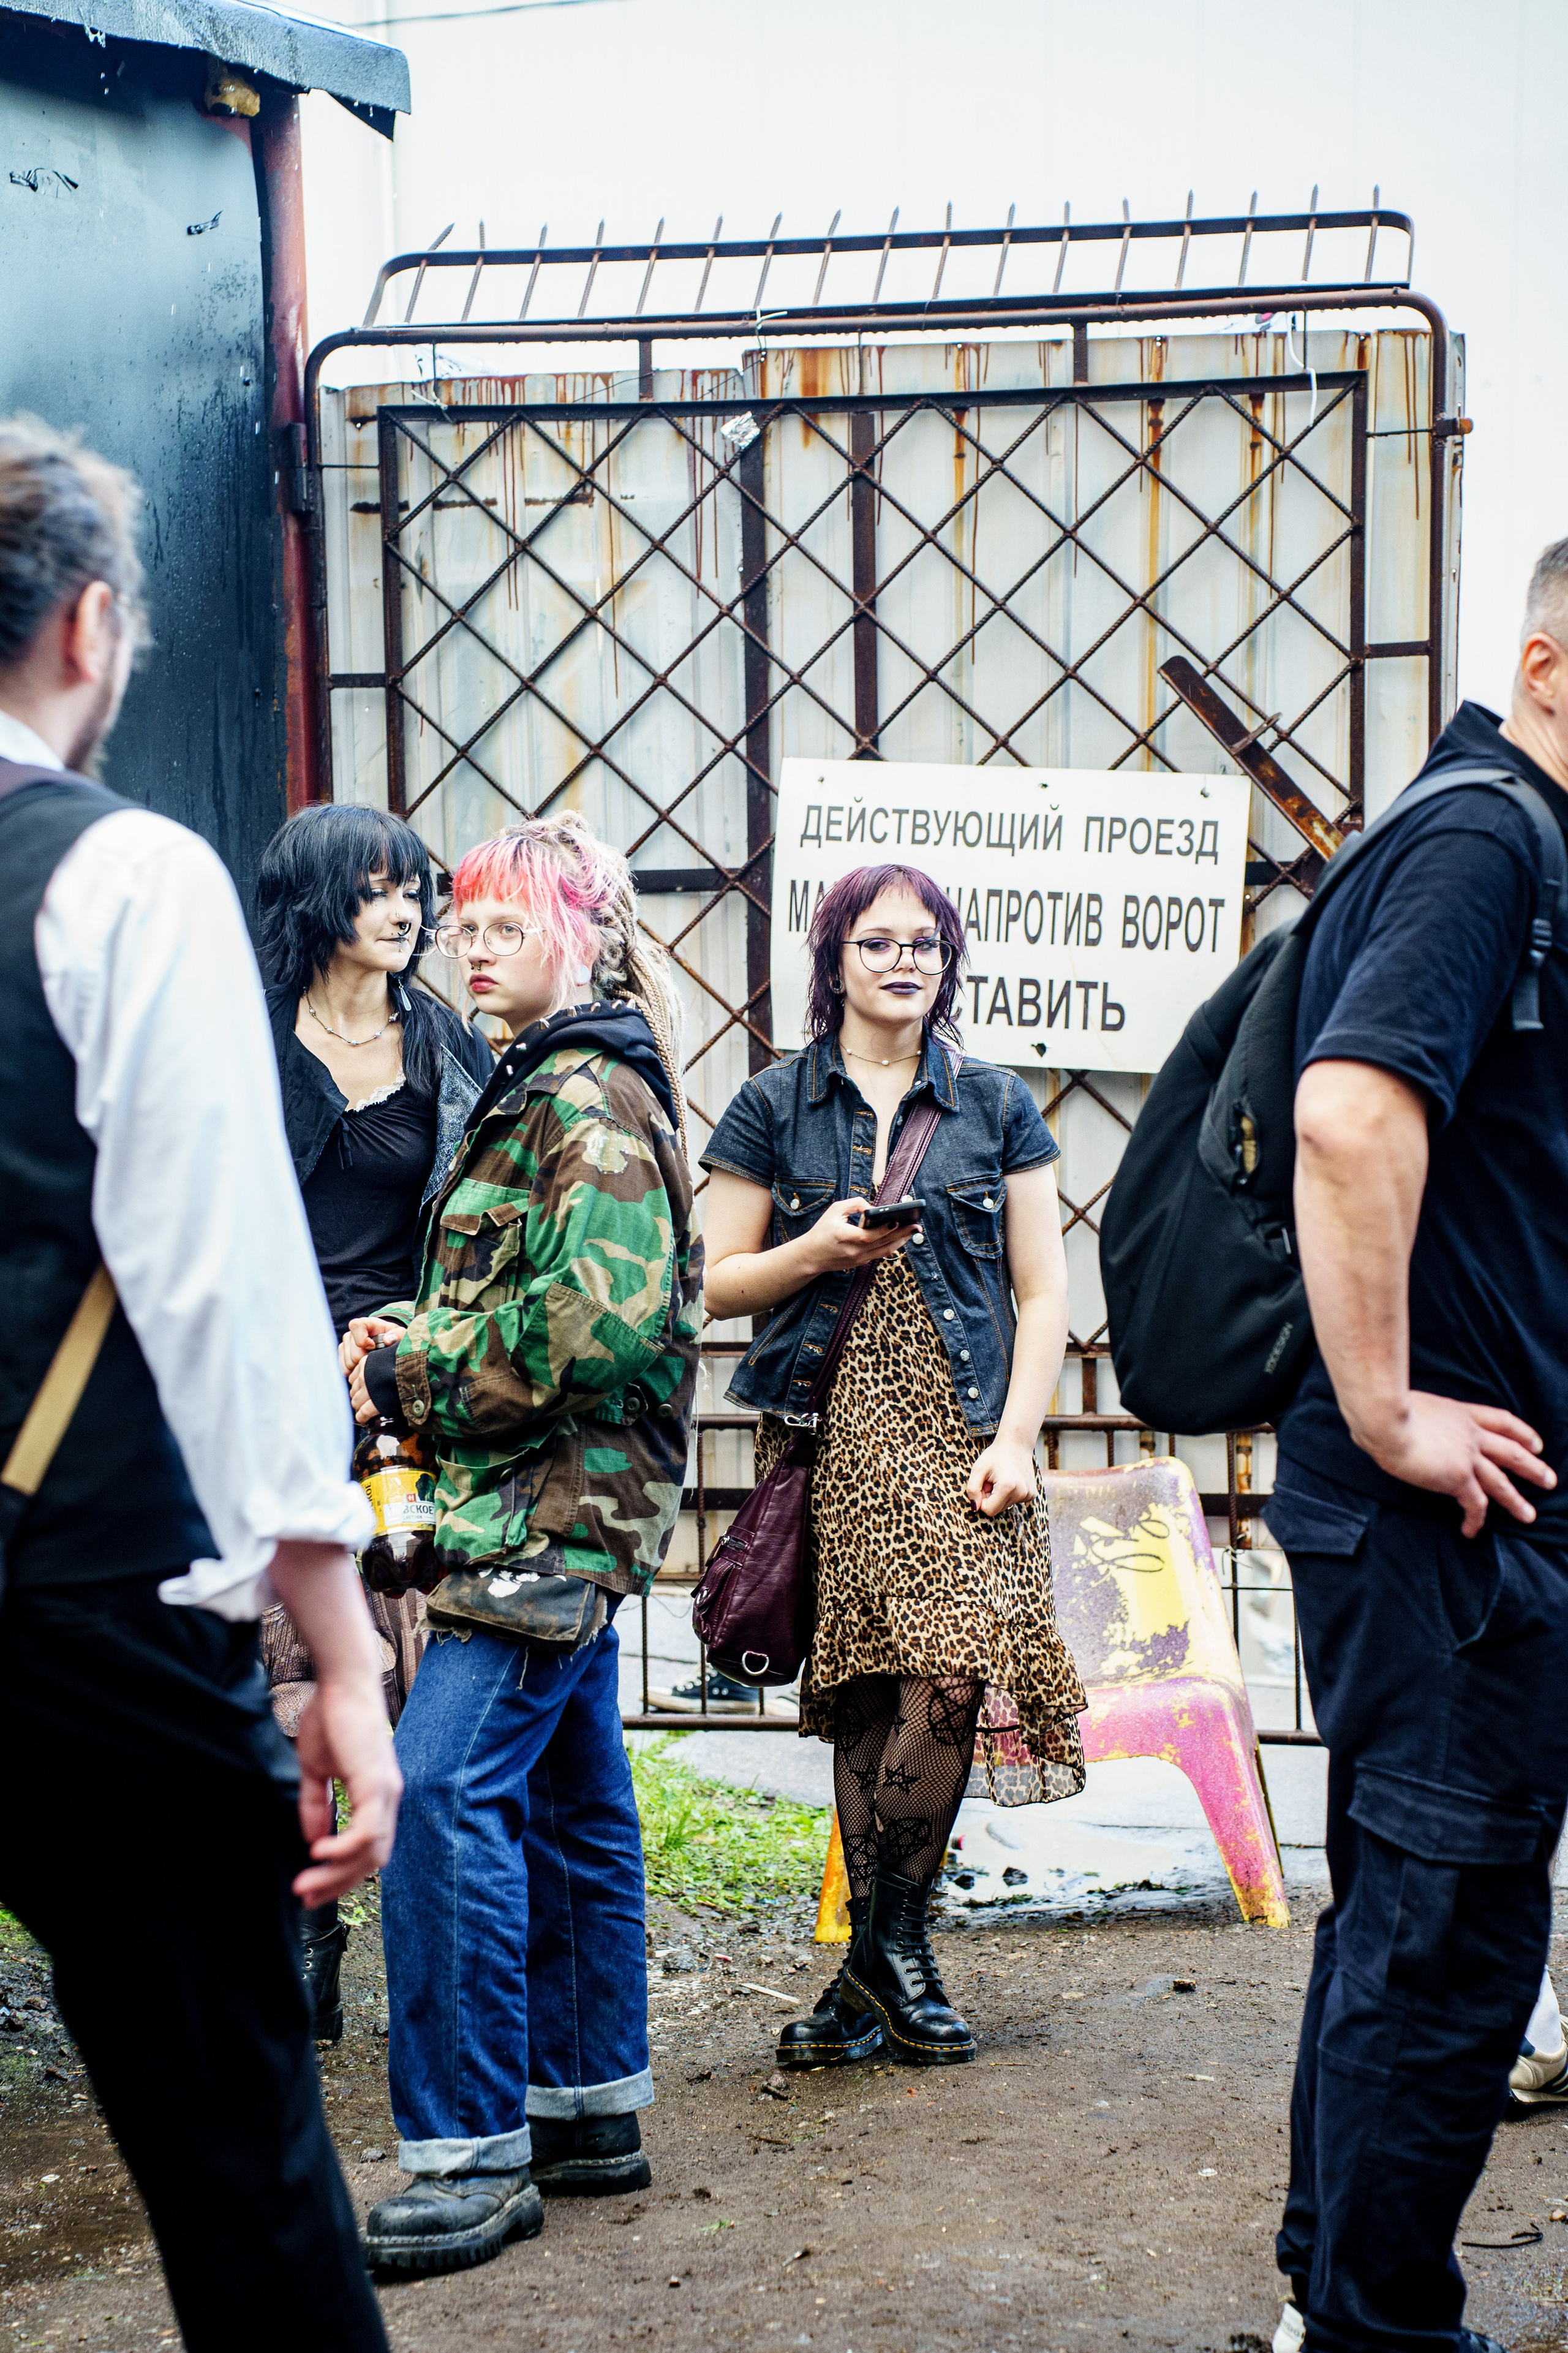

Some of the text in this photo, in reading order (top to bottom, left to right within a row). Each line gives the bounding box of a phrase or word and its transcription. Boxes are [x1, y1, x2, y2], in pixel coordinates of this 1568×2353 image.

[801, 796, 1219, 864] ДЕЙСТВУЮЩИЙ ПРОЕЗД
[1121, 894, 1225, 953] ВОРОТ
[952, 975, 1126, 1031] ТАВИТЬ
